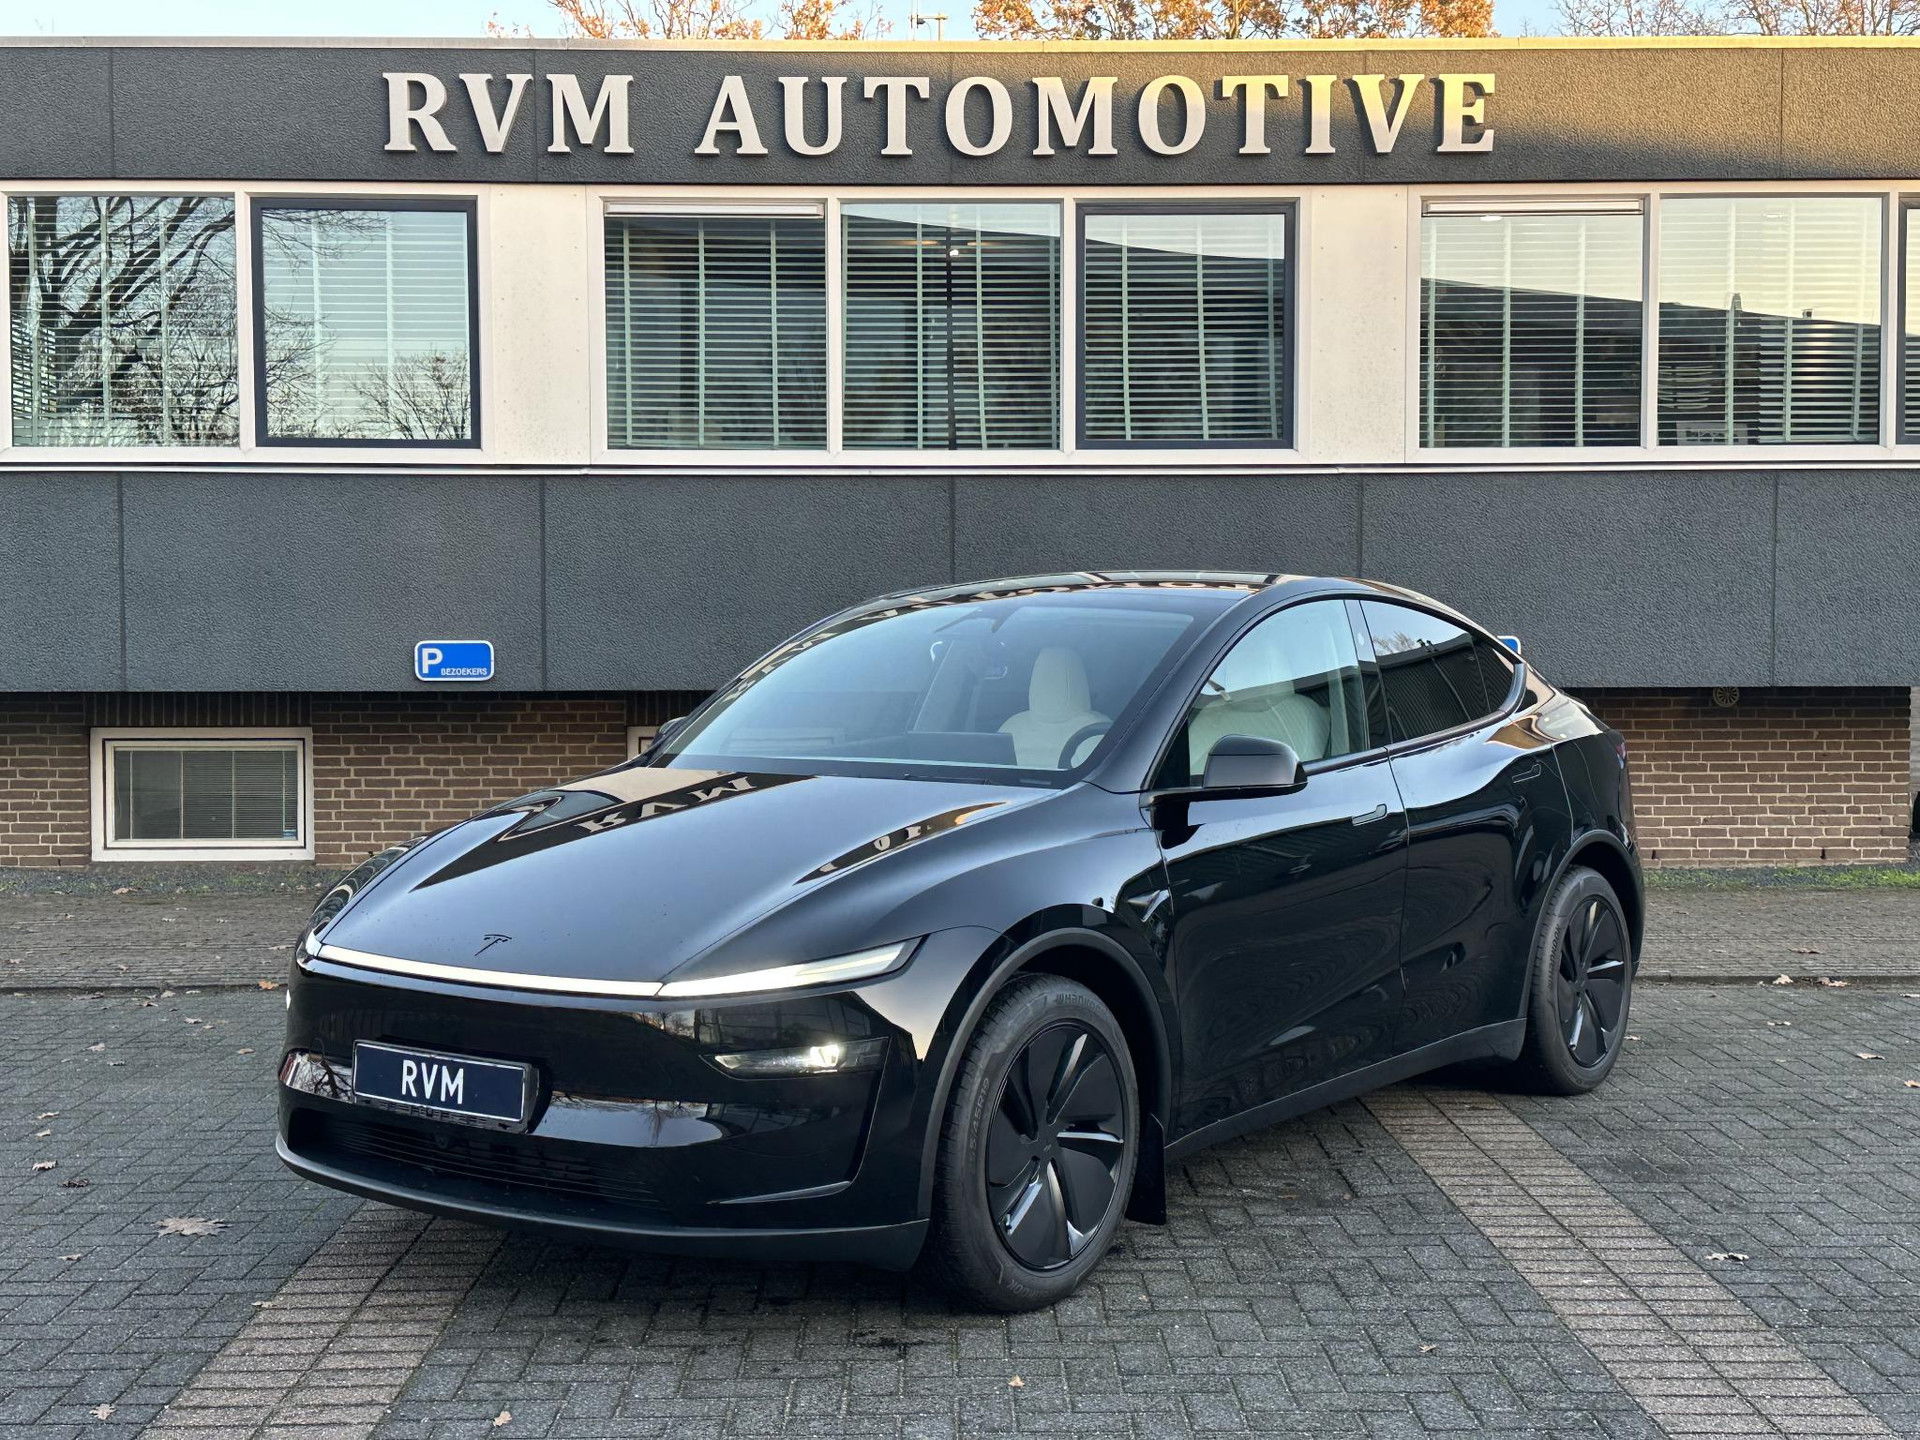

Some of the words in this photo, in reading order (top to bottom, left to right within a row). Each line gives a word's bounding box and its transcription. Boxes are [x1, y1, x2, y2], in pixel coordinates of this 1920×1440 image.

[382, 72, 634, 152] RVM
[694, 73, 1496, 156] AUTOMOTIVE
[422, 648, 443, 674] P
[441, 667, 488, 676] BEZOEKERS
[401, 1059, 464, 1105] RVM
